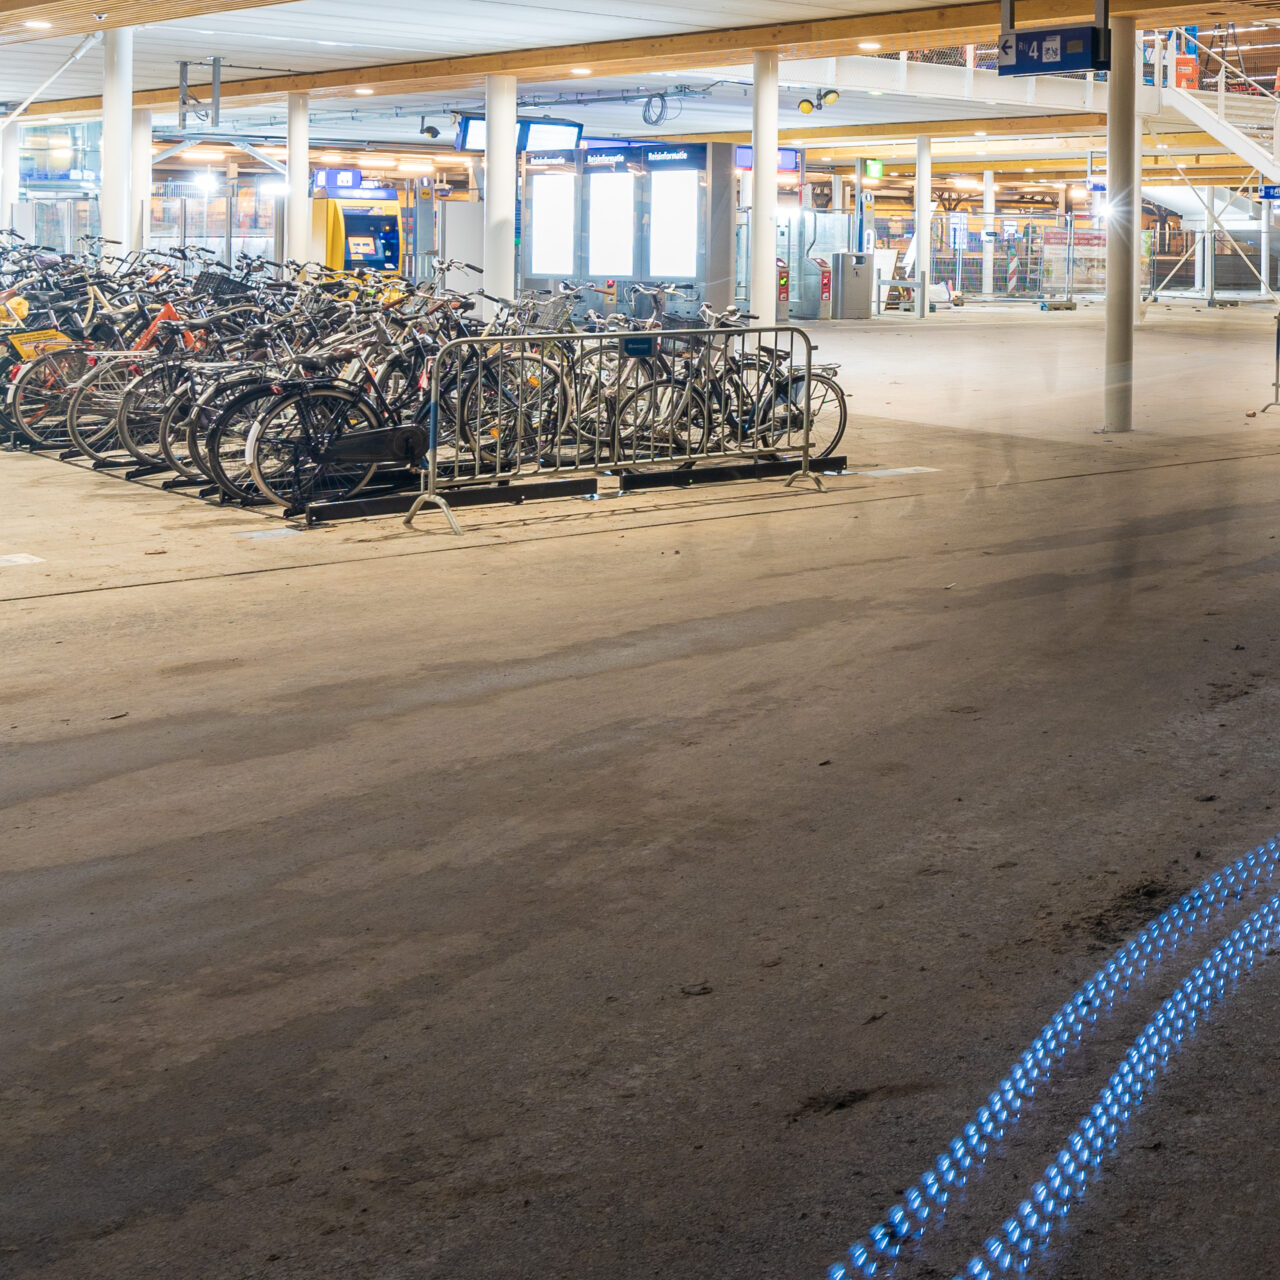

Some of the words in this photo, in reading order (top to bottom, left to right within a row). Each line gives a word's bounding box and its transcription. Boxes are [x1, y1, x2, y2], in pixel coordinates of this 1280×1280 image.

[1018, 41, 1028, 52] Rij
[1028, 40, 1039, 60] 4
[587, 153, 625, 164] Reisinformatie
[648, 150, 688, 161] Reisinformatie
